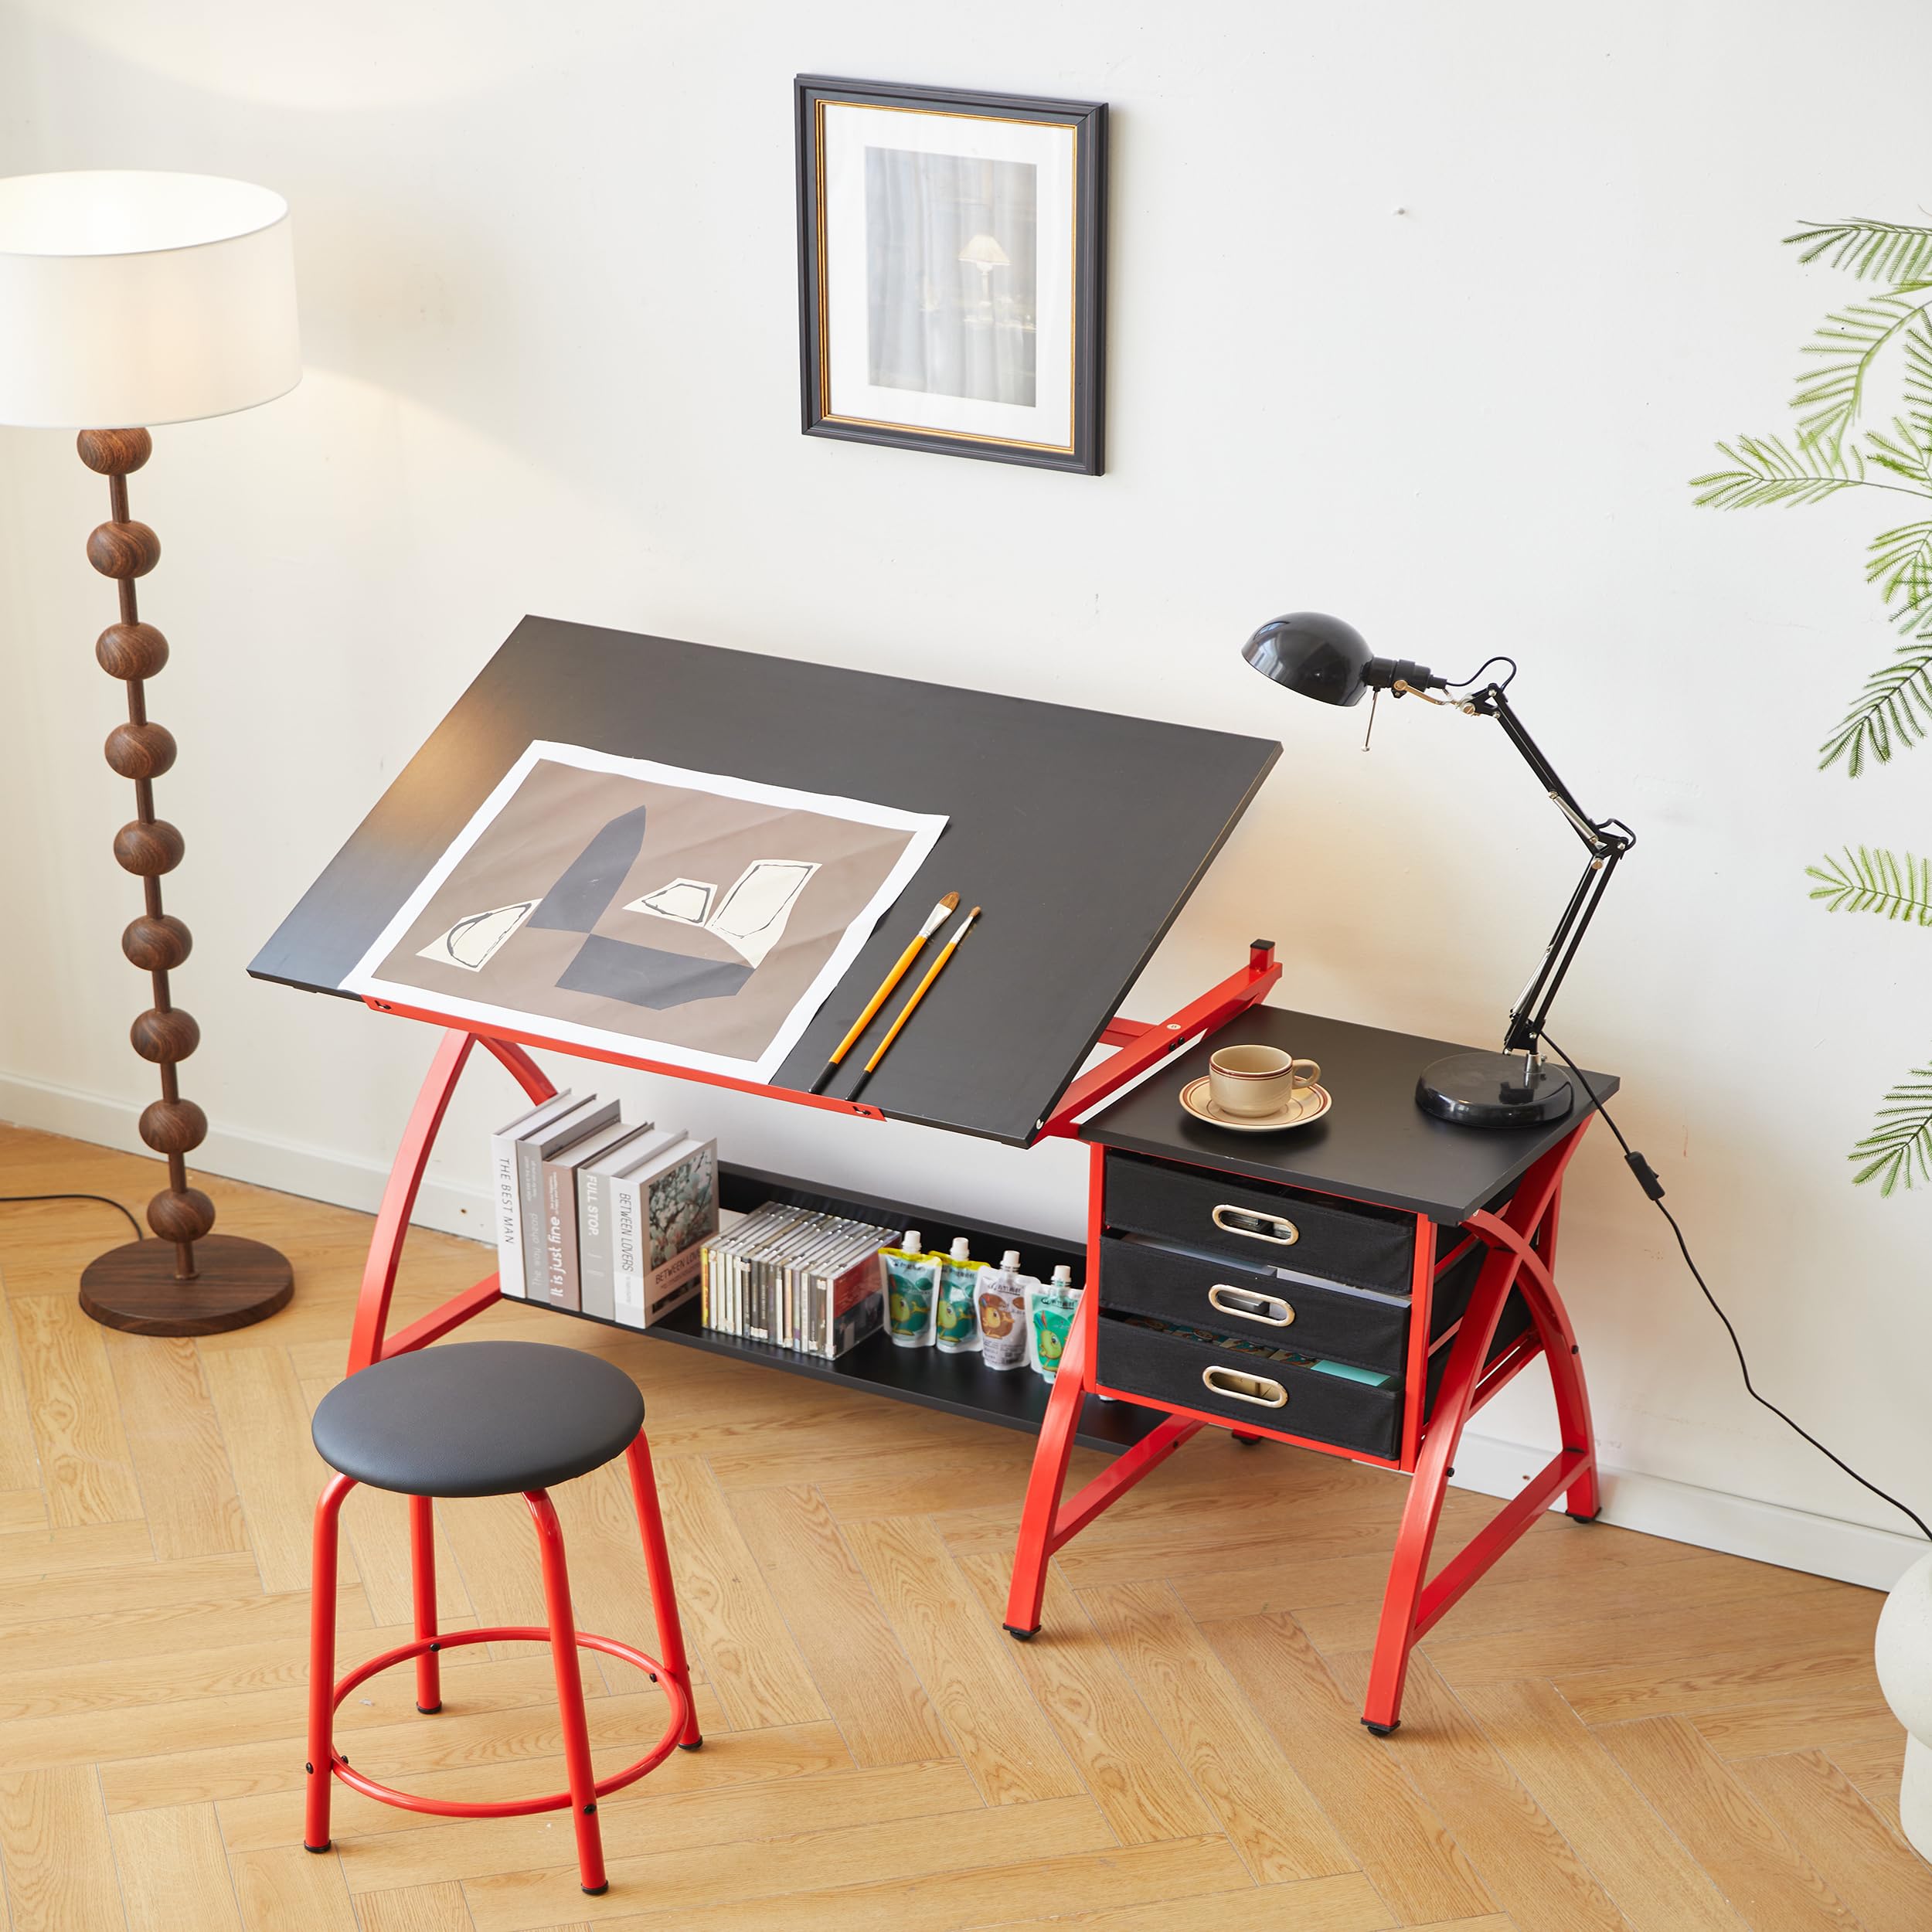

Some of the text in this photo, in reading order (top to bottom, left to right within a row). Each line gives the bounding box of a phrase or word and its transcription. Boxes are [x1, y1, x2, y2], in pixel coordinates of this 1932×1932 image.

[500, 1158, 515, 1244] THE BEST MAN
[587, 1175, 599, 1236] FULL STOP.
[619, 1192, 632, 1236] BETWEEN
[547, 1216, 561, 1244] fine
[548, 1247, 566, 1274] just
[621, 1237, 634, 1272] LOVERS
[549, 1275, 563, 1285] is
[655, 1260, 685, 1284] BETWEEN
[549, 1287, 563, 1298] It
